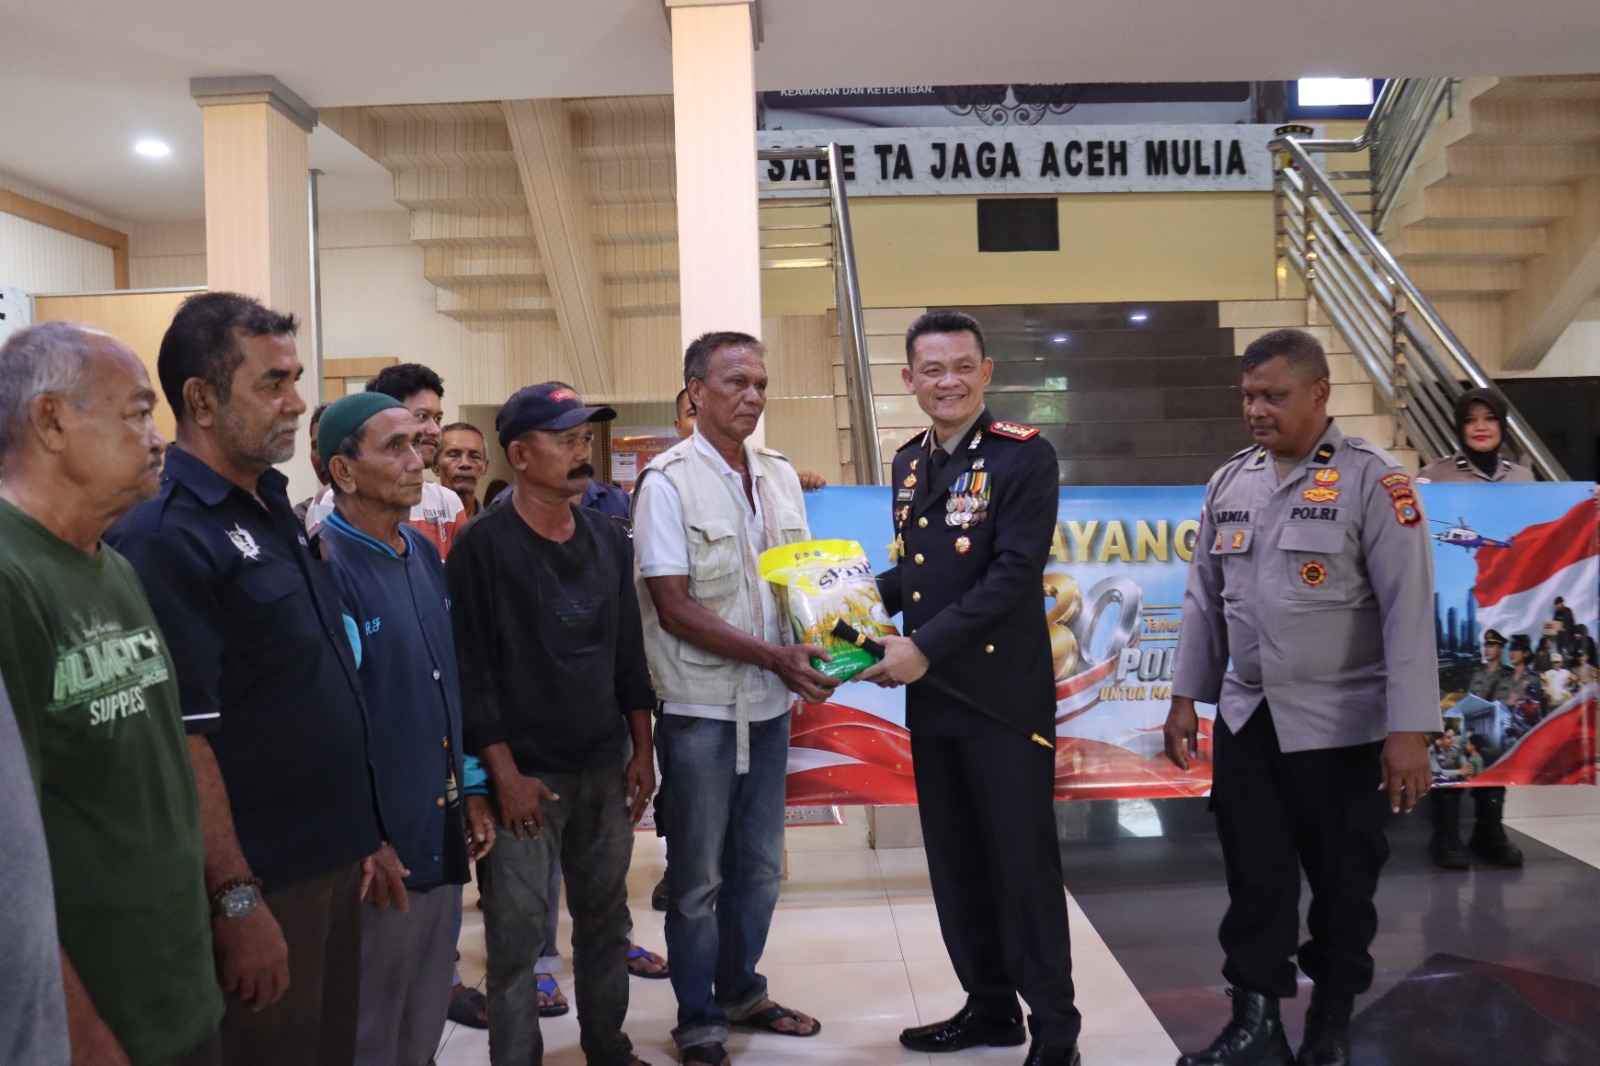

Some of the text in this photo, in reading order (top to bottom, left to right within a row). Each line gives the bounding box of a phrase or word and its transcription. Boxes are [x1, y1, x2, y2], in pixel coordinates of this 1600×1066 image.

[781, 86, 841, 97] KEAMANAN
[842, 86, 865, 96] DAN
[874, 144, 914, 180] TA
[930, 142, 1021, 179] JAGA
[1040, 140, 1128, 178] ACEH
[1146, 139, 1247, 176] MULIA
[1290, 507, 1338, 522] POLRI
